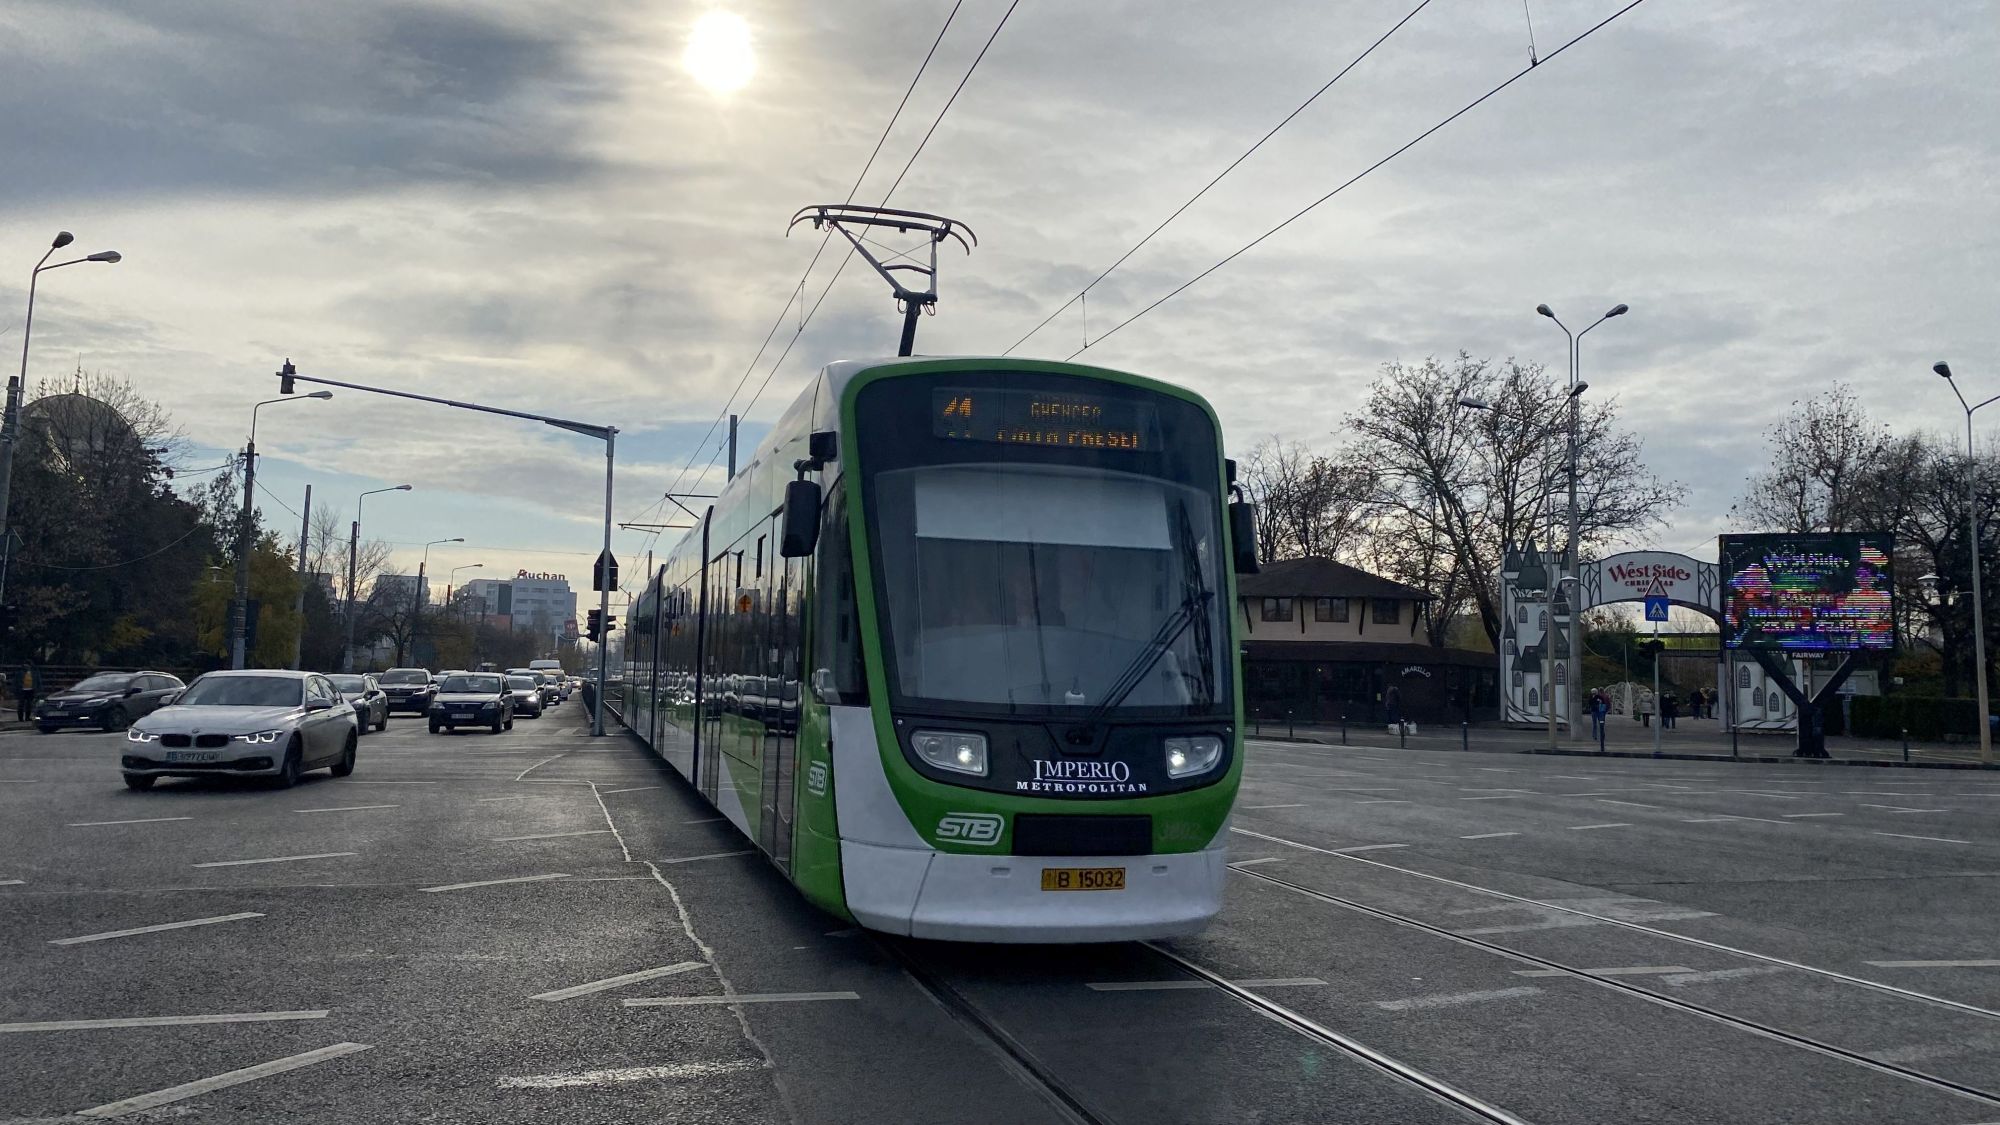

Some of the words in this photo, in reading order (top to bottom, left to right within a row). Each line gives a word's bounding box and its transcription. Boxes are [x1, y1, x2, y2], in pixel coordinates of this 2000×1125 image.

[517, 569, 566, 580] Auchan
[1608, 562, 1650, 582] West
[1652, 563, 1691, 581] Side
[1401, 665, 1431, 678] AMARILLO
[1033, 759, 1130, 783] IMPERIO
[1016, 780, 1147, 793] METROPOLITAN
[935, 817, 998, 839] STB
[1057, 871, 1070, 888] B
[1078, 870, 1123, 888] 15032
